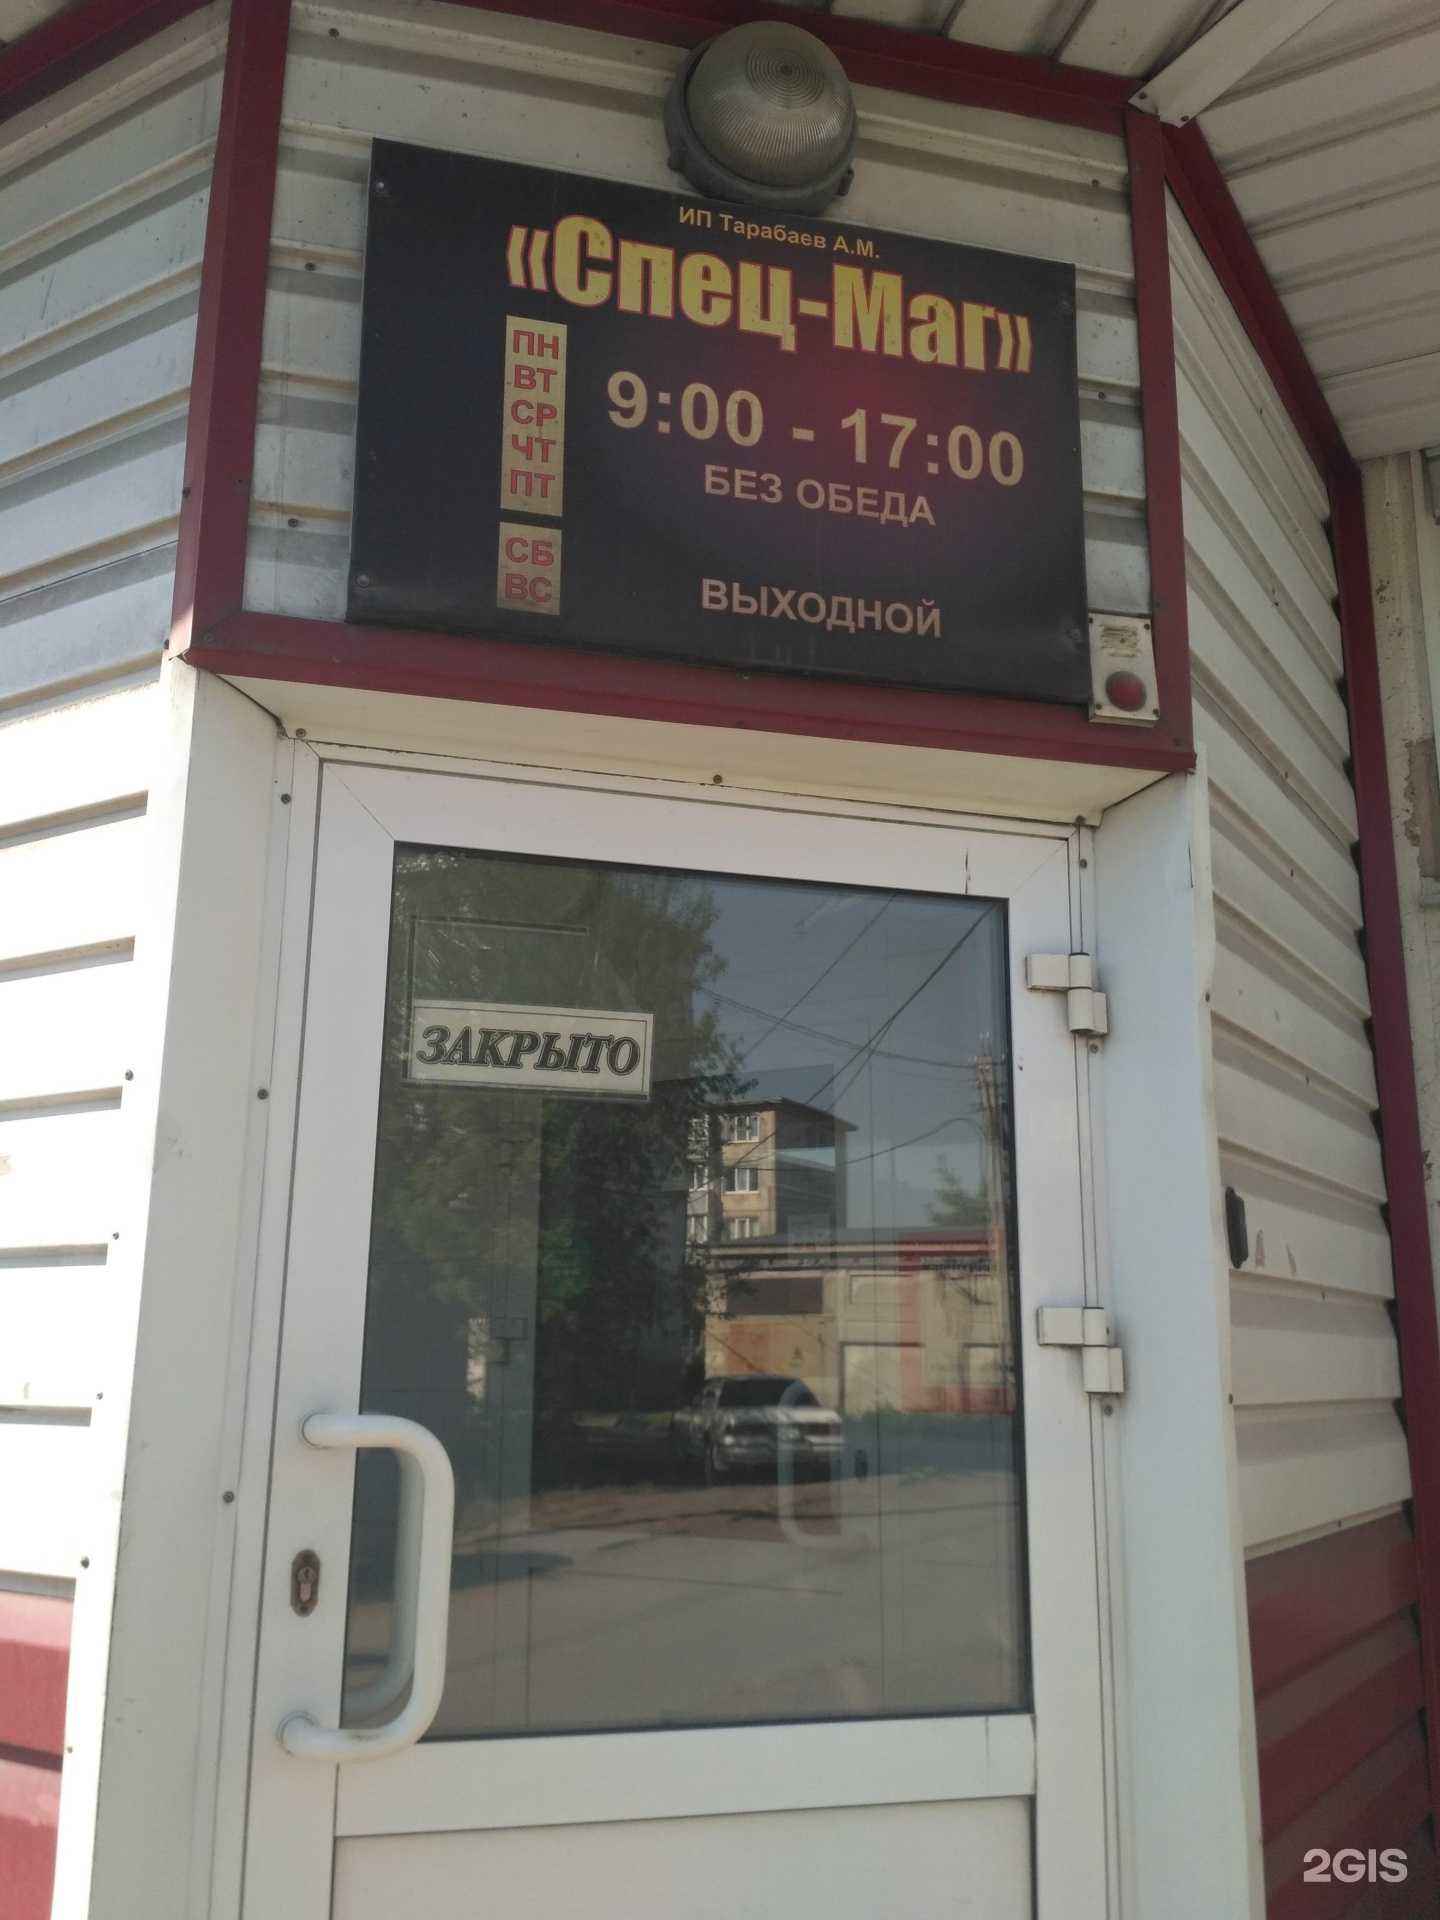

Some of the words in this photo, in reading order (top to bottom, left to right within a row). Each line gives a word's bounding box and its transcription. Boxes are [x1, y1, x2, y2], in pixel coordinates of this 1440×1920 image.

[679, 206, 712, 228] ИП
[719, 213, 827, 249] Тарабаев
[833, 235, 880, 259] А.М.
[505, 213, 1034, 374] «Спец-Маг»
[512, 330, 559, 360] ПН
[513, 364, 557, 393] ВТ
[510, 400, 558, 427] СР
[607, 371, 764, 447] 9:00
[792, 427, 815, 442] -
[841, 408, 1025, 487] 17:00
[511, 434, 556, 463] ЧТ
[509, 469, 556, 498] ПТ
[704, 464, 783, 504] БЕЗ
[796, 479, 937, 528] ОБЕДА
[505, 537, 554, 567] СБ
[504, 573, 552, 603] ВС
[702, 578, 942, 639] ВЫХОДНОЙ
[415, 1024, 642, 1077] ЗАКРЫТО
